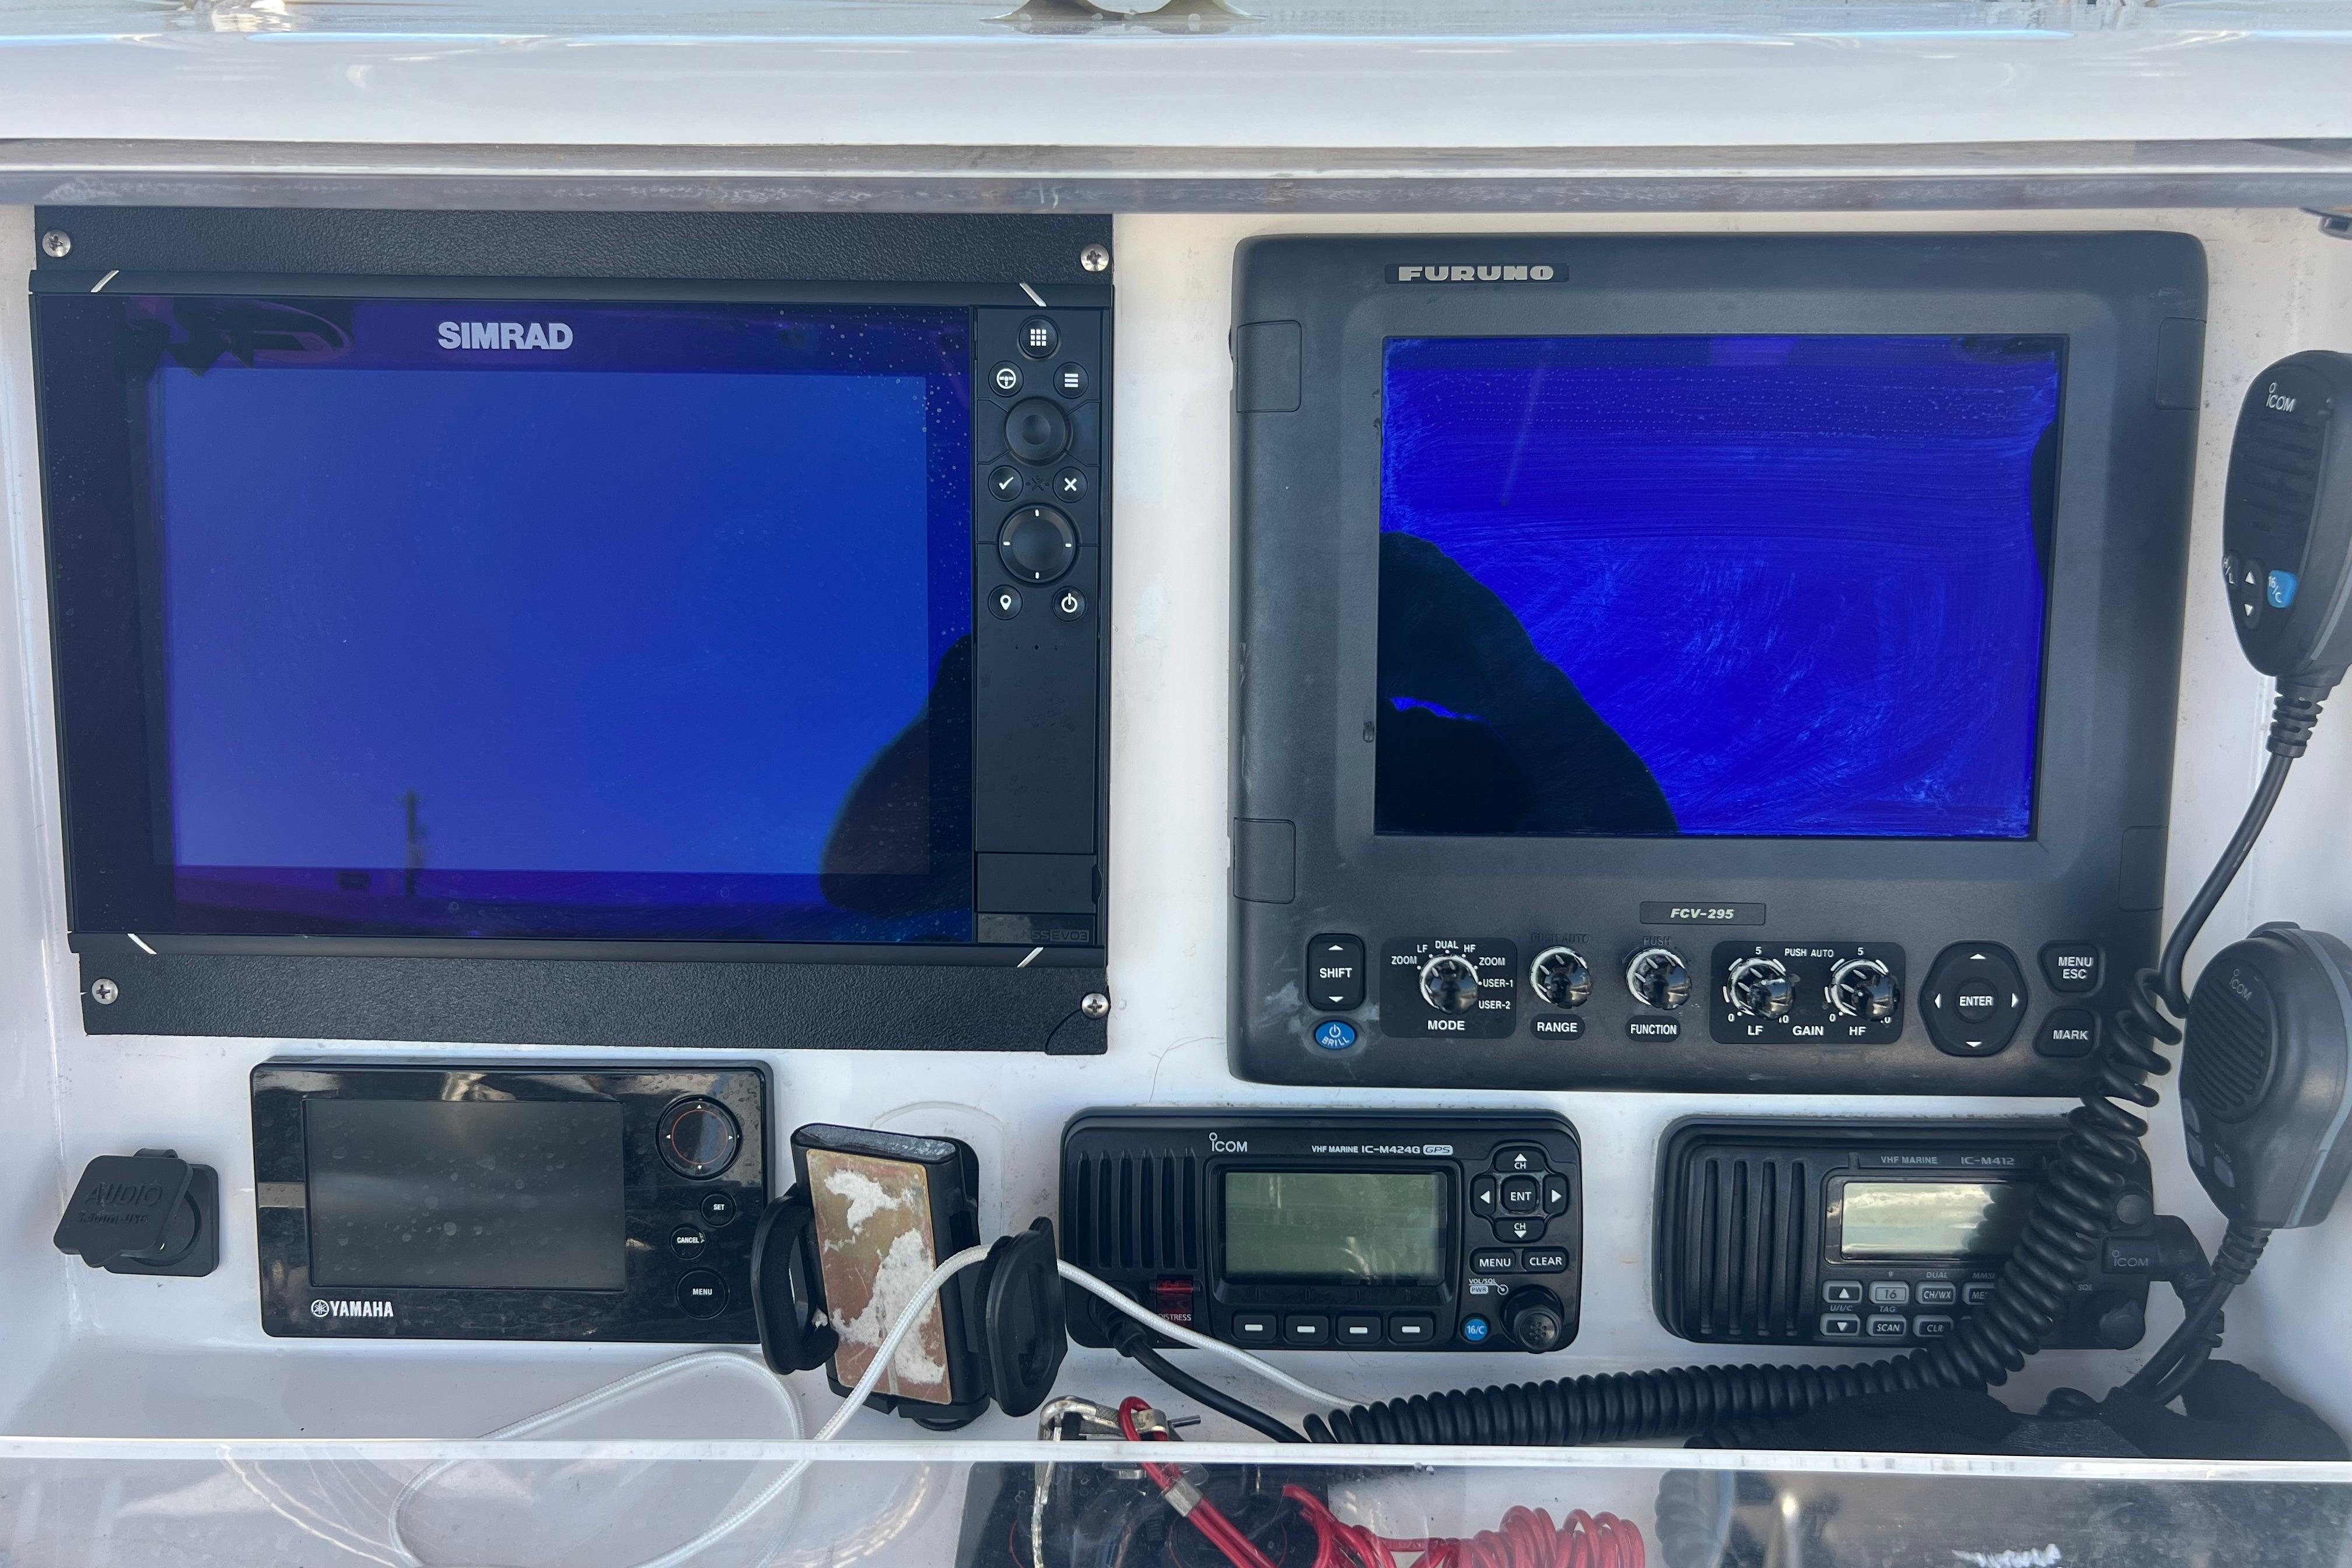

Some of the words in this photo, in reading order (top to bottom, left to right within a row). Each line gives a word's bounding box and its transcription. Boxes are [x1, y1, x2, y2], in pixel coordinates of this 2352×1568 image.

[1399, 266, 1553, 281] FURUNO
[438, 321, 573, 349] SIMRAD
[1670, 908, 1735, 919] FCV-295
[1435, 940, 1458, 950] DUAL
[1643, 936, 1671, 946] PUSH
[1417, 944, 1427, 953] LF
[1464, 944, 1476, 953] HF
[1755, 946, 1762, 955] 5
[1784, 948, 1807, 957] PUSH
[1810, 949, 1834, 958] AUTO
[1857, 947, 1864, 956] 5
[1391, 956, 1418, 965] ZOOM
[1479, 957, 1506, 966] ZOOM
[2059, 957, 2092, 967] MENU
[1320, 968, 1352, 978] SHIFT
[2063, 969, 2087, 979] ESC
[1483, 979, 1513, 988] USER-1
[1478, 1000, 1510, 1009] USER-2
[1959, 996, 1993, 1006] ENTER
[1427, 1020, 1465, 1030] MODE
[1537, 1022, 1577, 1032] RANGE
[1630, 1024, 1677, 1034] FUNCTION
[1748, 1026, 1763, 1035] LF
[1793, 1026, 1824, 1035] GAIN
[1849, 1027, 1866, 1035] HF
[2053, 1030, 2088, 1040] MARK
[1322, 1037, 1350, 1046] BRILL
[1961, 1157, 2014, 1165] IC-M412
[85, 1183, 163, 1207] AUDIO
[1510, 1192, 1531, 1201] ENT
[1479, 1258, 1511, 1267] MENU
[1530, 1257, 1562, 1266] CLEAR
[1885, 1290, 1896, 1298] 16
[330, 1301, 394, 1317] YAMAHA
[1467, 1326, 1485, 1334] 16/C
